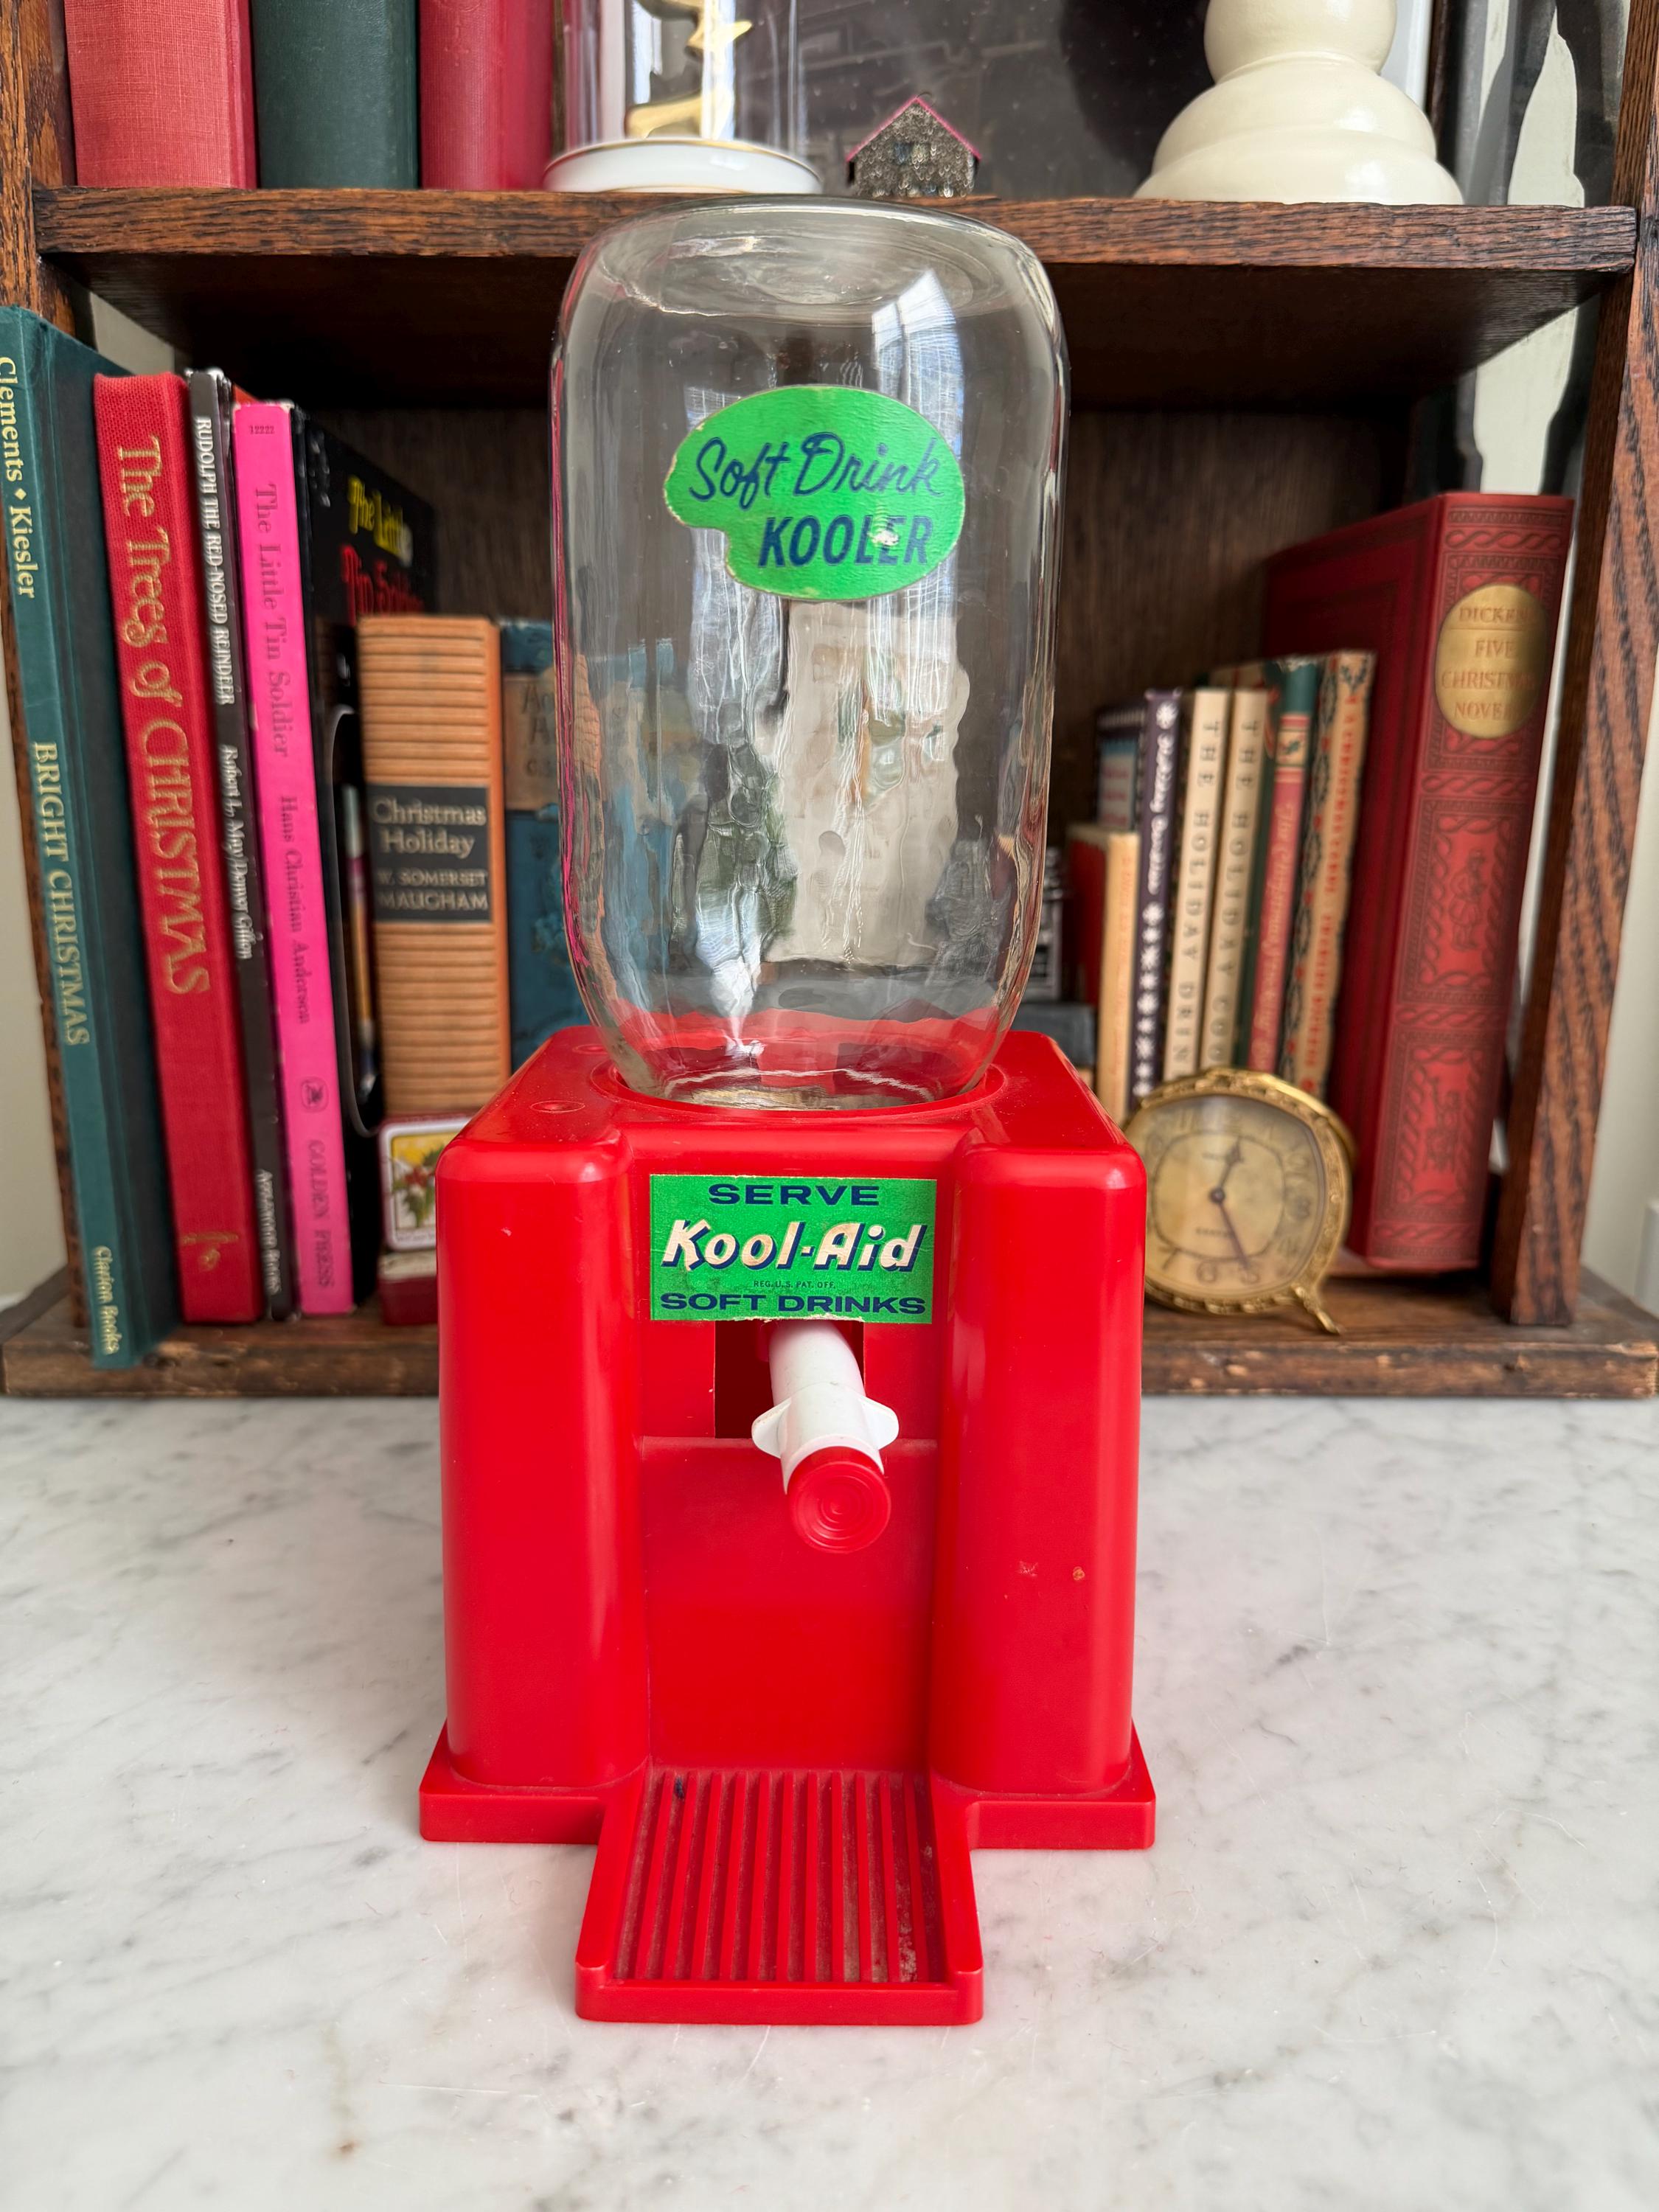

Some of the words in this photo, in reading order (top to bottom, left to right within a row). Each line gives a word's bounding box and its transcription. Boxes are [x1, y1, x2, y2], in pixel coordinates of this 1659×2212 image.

[0, 356, 24, 481] Clements
[117, 434, 163, 517] The
[193, 416, 218, 494] RUDOLPH
[689, 437, 790, 511] Soft
[793, 431, 945, 498] Drink
[199, 495, 221, 530] THE
[255, 482, 279, 534] The
[757, 515, 933, 568] KOOLER
[10, 505, 39, 599] Kiesler
[204, 531, 229, 625] RED-NOSED
[260, 543, 285, 611] Little
[122, 524, 171, 649] Trees
[209, 626, 235, 705] REINDEER
[264, 616, 288, 661] Tin
[1475, 638, 1517, 659] FIVE
[131, 659, 183, 708] of
[268, 670, 293, 759] Soldier
[32, 740, 69, 863] BRIGHT
[279, 796, 298, 844] Hans
[373, 796, 487, 826] Christmas
[142, 718, 211, 995] CHRISTMAS
[380, 826, 476, 859] Holiday
[285, 849, 307, 933] Christian
[378, 890, 489, 911] MAUGHAM
[399, 868, 488, 886] SOMERSET
[47, 869, 91, 1046] CHRISTMAS
[1171, 981, 1195, 1075] DRIN
[1206, 995, 1236, 1063] COO
[708, 1183, 880, 1206] SERVE
[661, 1218, 928, 1272] Kool-Aid
[660, 1292, 767, 1311] SOFT
[777, 1295, 926, 1315] DRINKS
